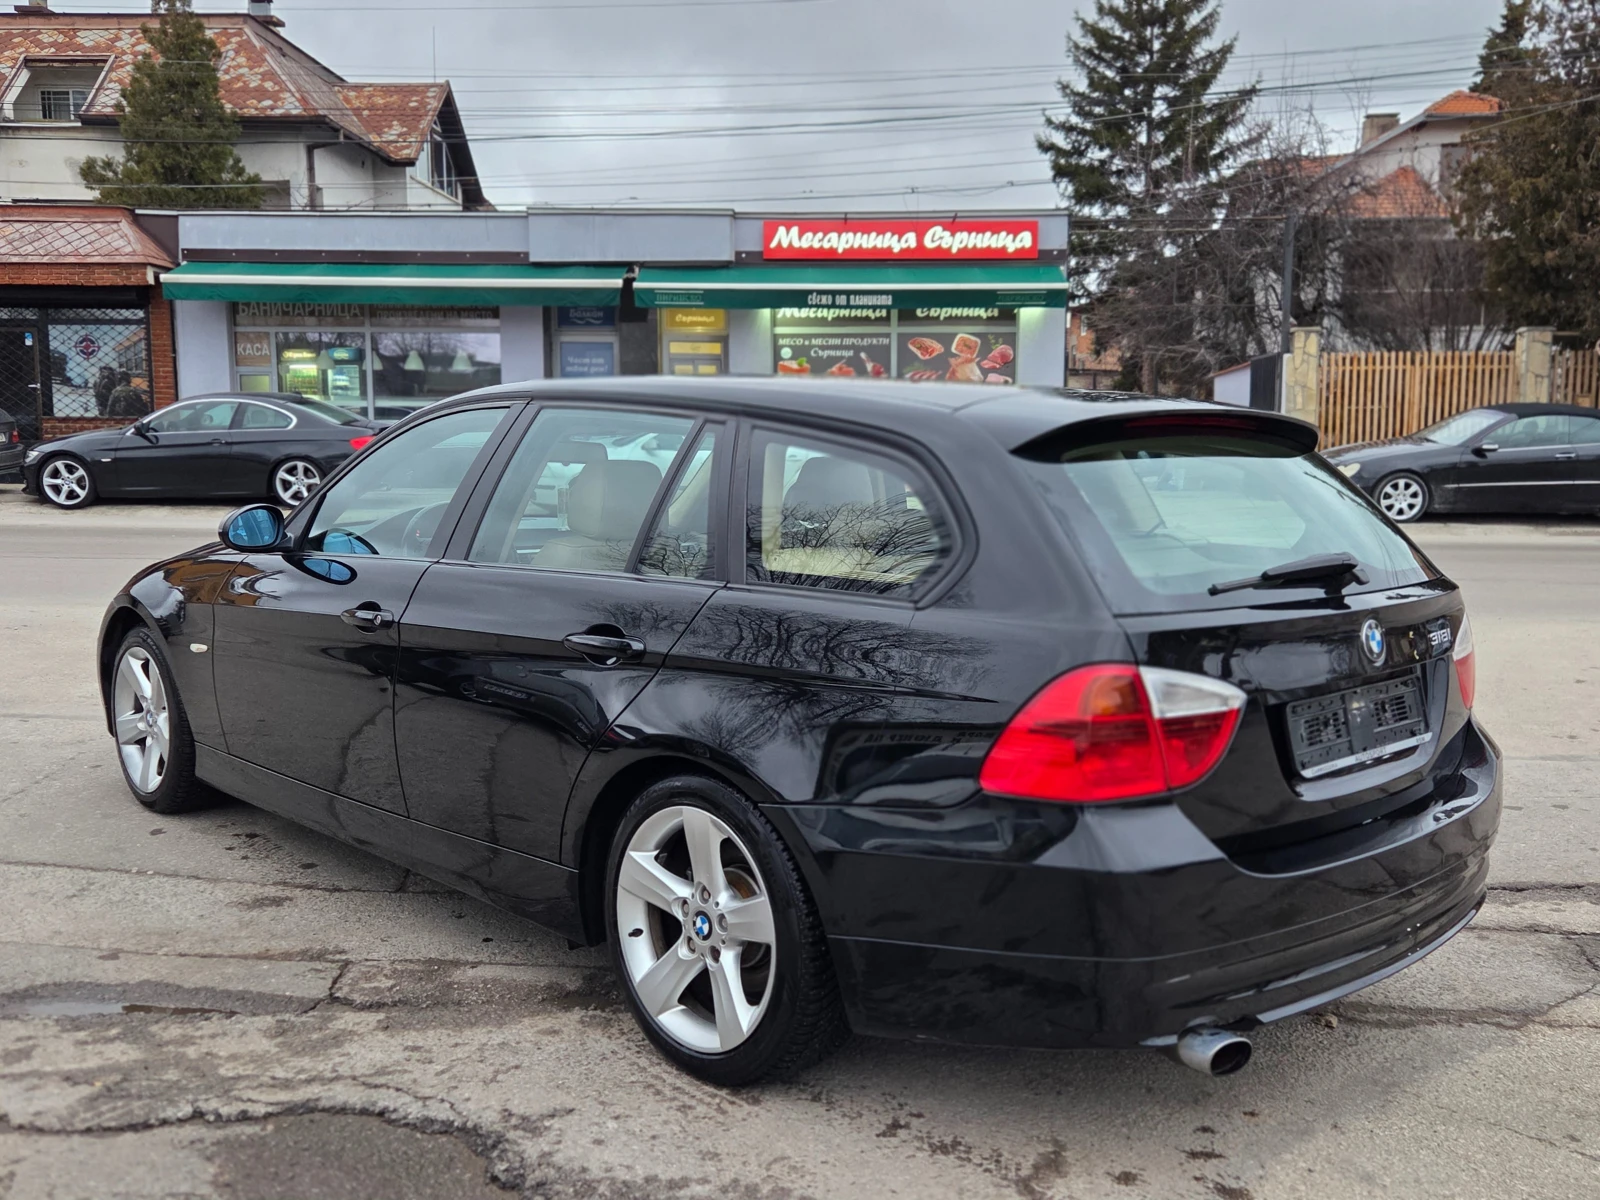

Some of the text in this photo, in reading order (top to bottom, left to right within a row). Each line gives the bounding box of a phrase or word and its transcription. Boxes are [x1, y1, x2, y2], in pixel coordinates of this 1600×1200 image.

[770, 225, 1033, 254] Месарница Сърница
[808, 292, 893, 306] свежо от планината
[238, 303, 362, 319] БАНИЧАРНИЦА
[777, 307, 887, 321] Месарница
[778, 337, 804, 346] МЕСО
[811, 337, 841, 346] МЕСНИ
[843, 337, 890, 346] ПРОДУКТИ
[237, 343, 270, 356] КАСА
[811, 347, 854, 359] Сърница
